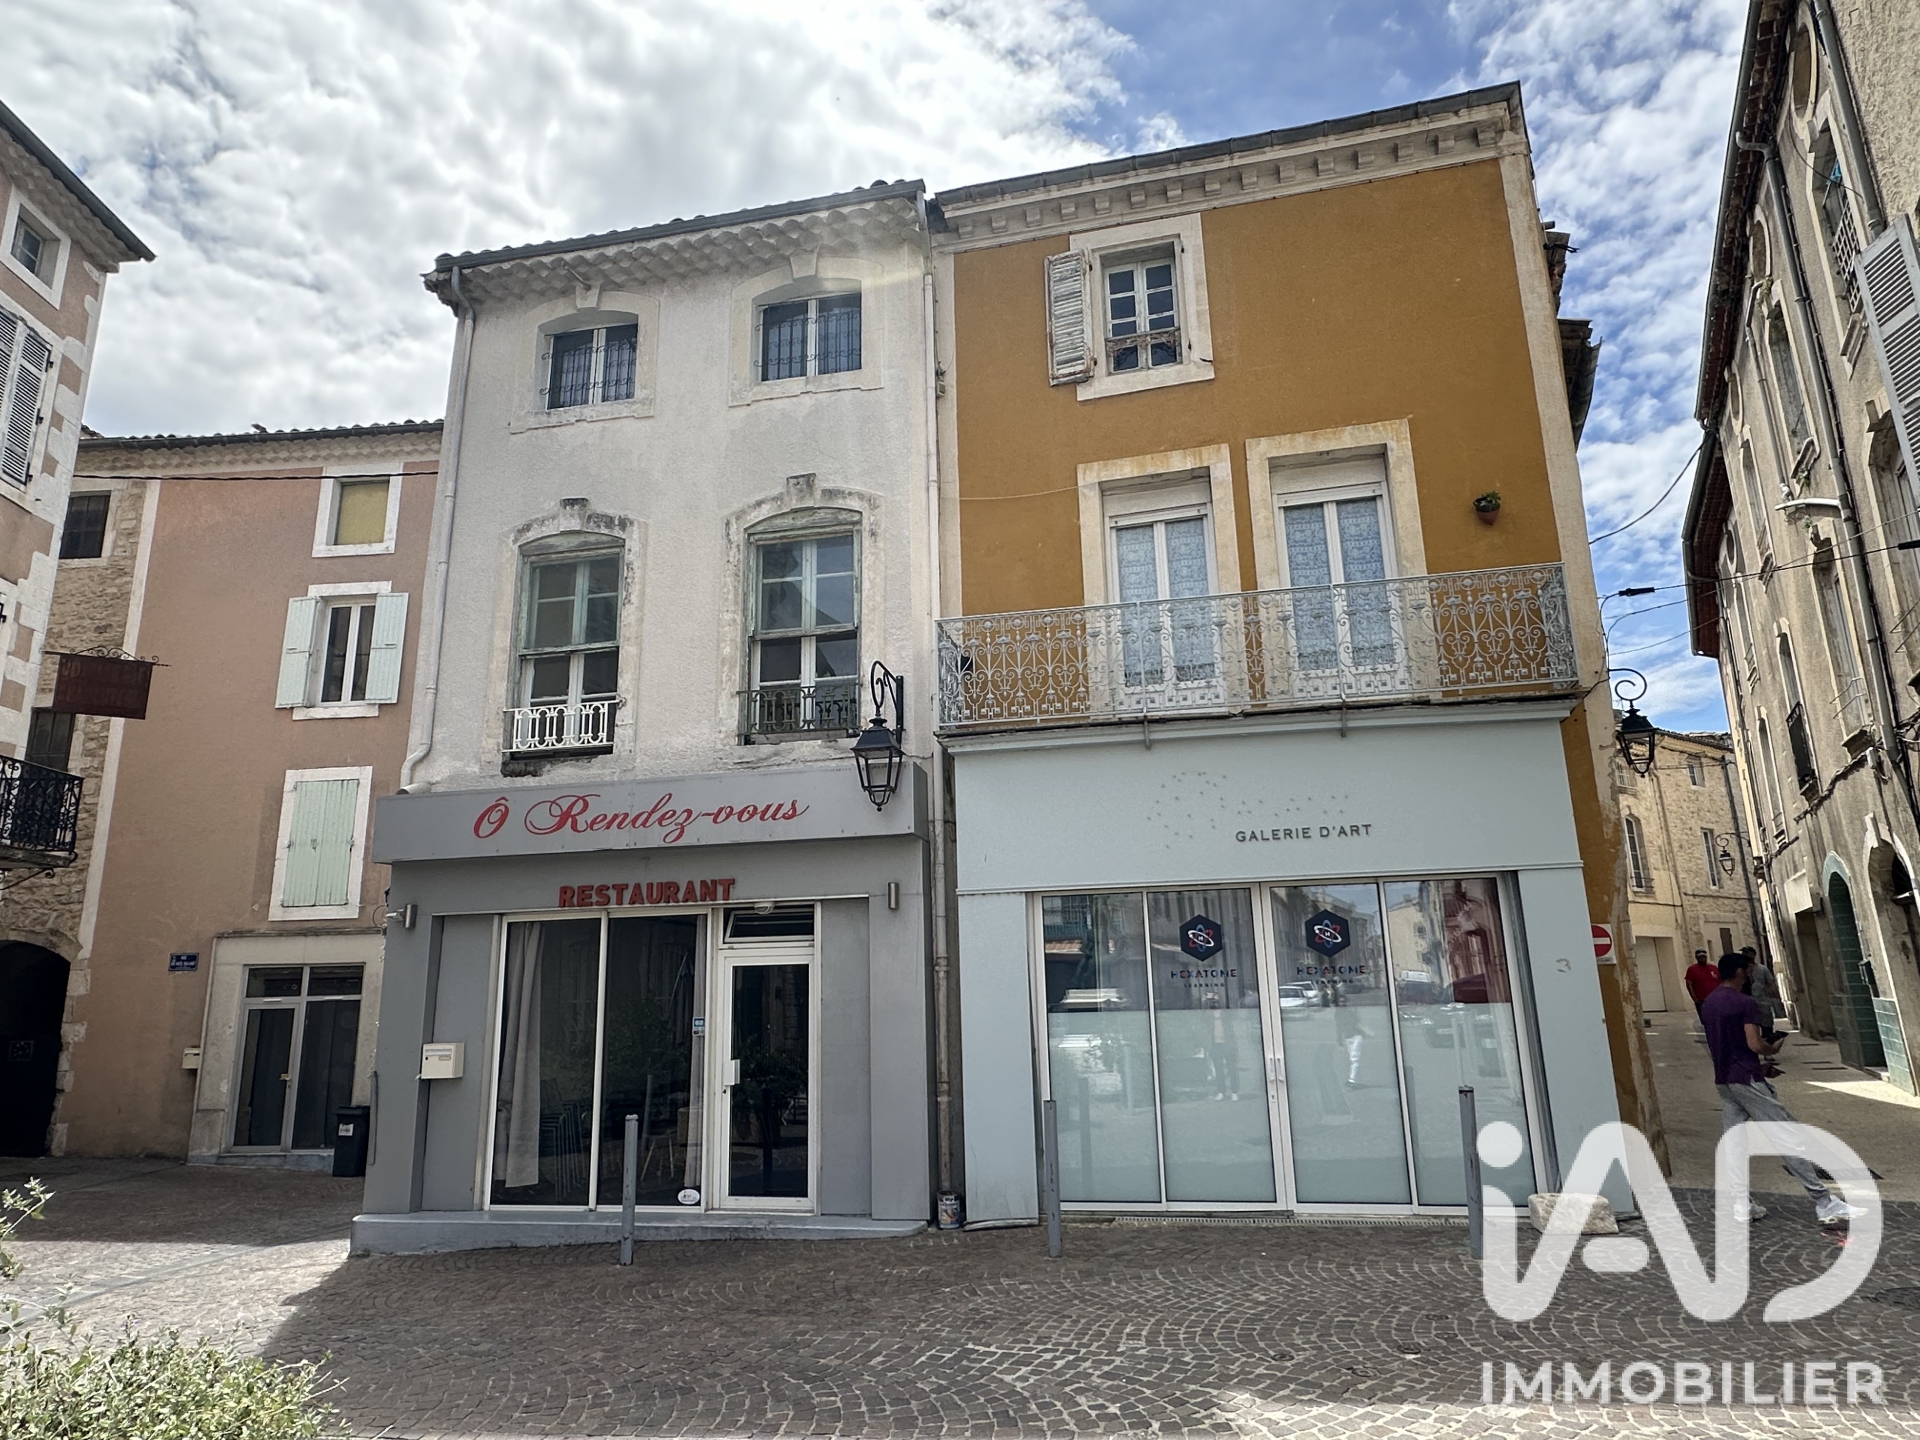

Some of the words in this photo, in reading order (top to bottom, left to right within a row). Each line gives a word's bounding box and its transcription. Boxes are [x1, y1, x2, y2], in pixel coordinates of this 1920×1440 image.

[473, 797, 509, 839] Ô
[524, 793, 810, 843] Rendez-vous
[1235, 828, 1312, 843] GALERIE
[1319, 824, 1372, 838] D'ART
[558, 878, 735, 908] RESTAURANT
